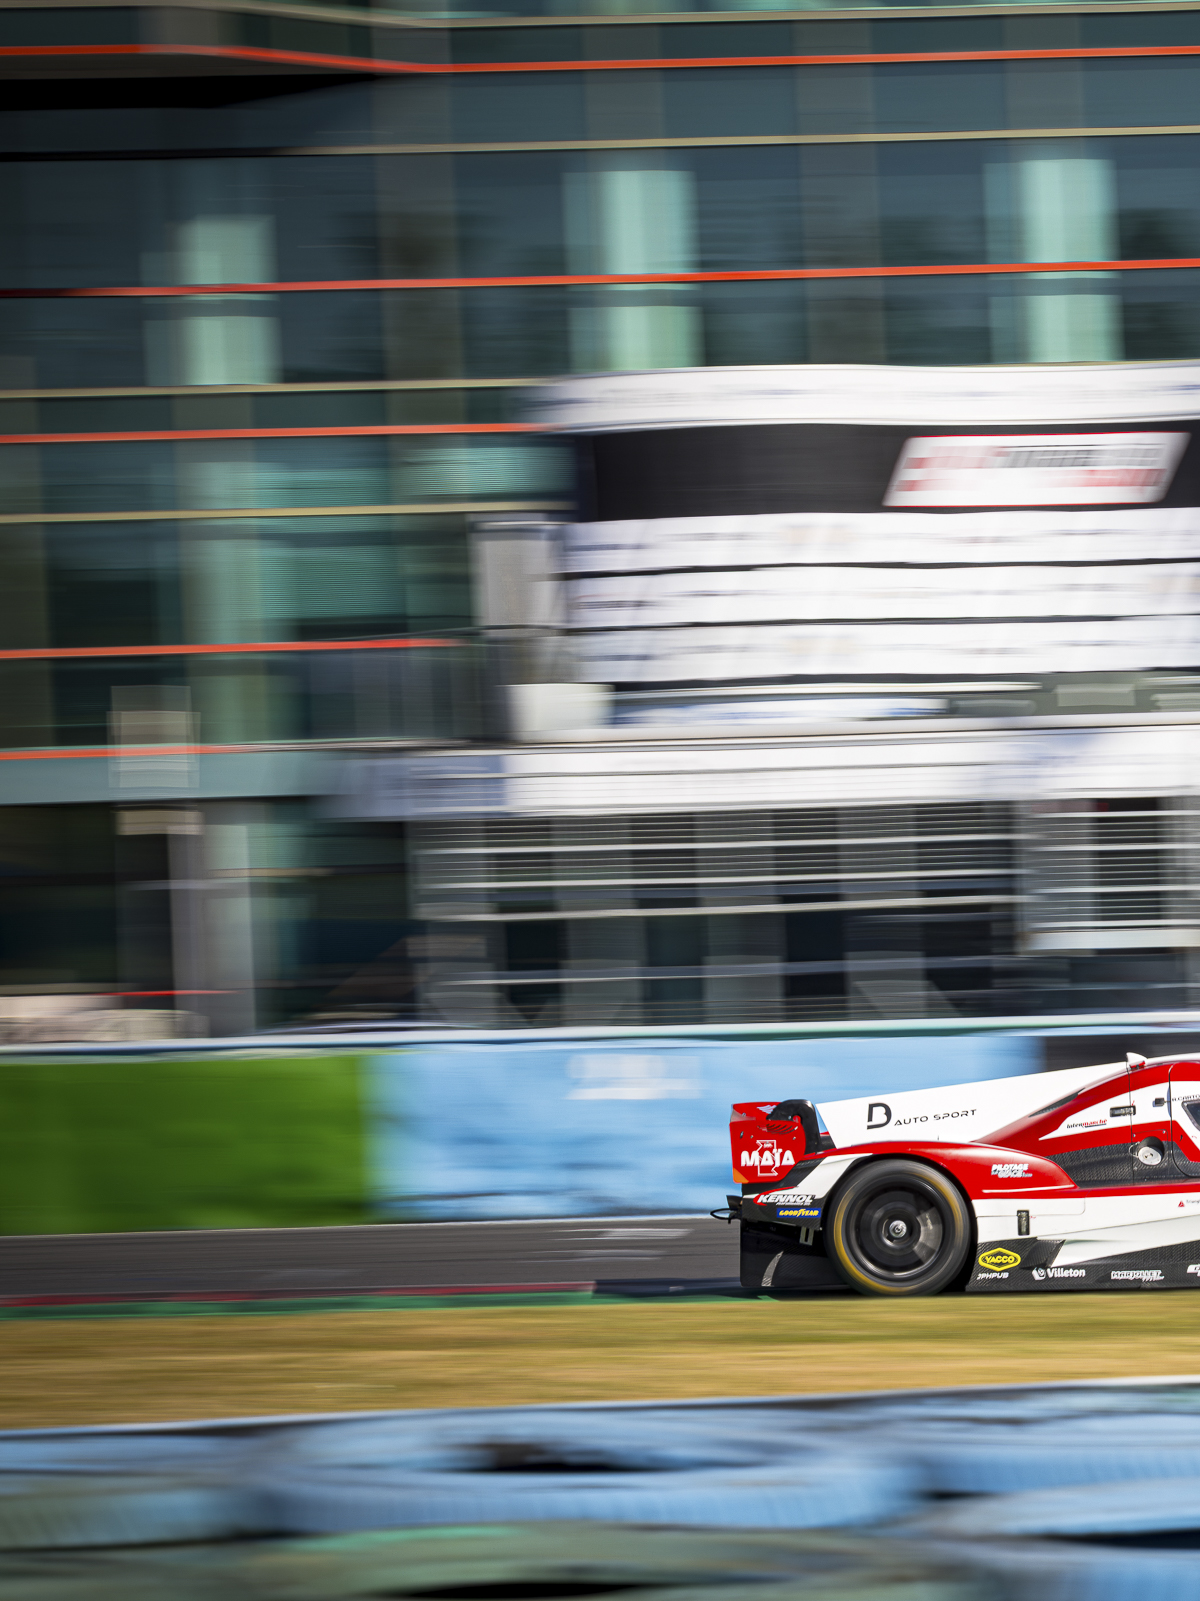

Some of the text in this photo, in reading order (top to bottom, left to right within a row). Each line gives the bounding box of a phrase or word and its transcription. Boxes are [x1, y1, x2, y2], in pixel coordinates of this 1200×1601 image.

[894, 1115, 929, 1127] AUTO
[933, 1109, 977, 1121] SPORT
[992, 1163, 1029, 1171] PILOTAGE
[757, 1194, 813, 1203] KENNOL
[985, 1255, 1015, 1264] YACCO
[1047, 1268, 1086, 1278] Villeton
